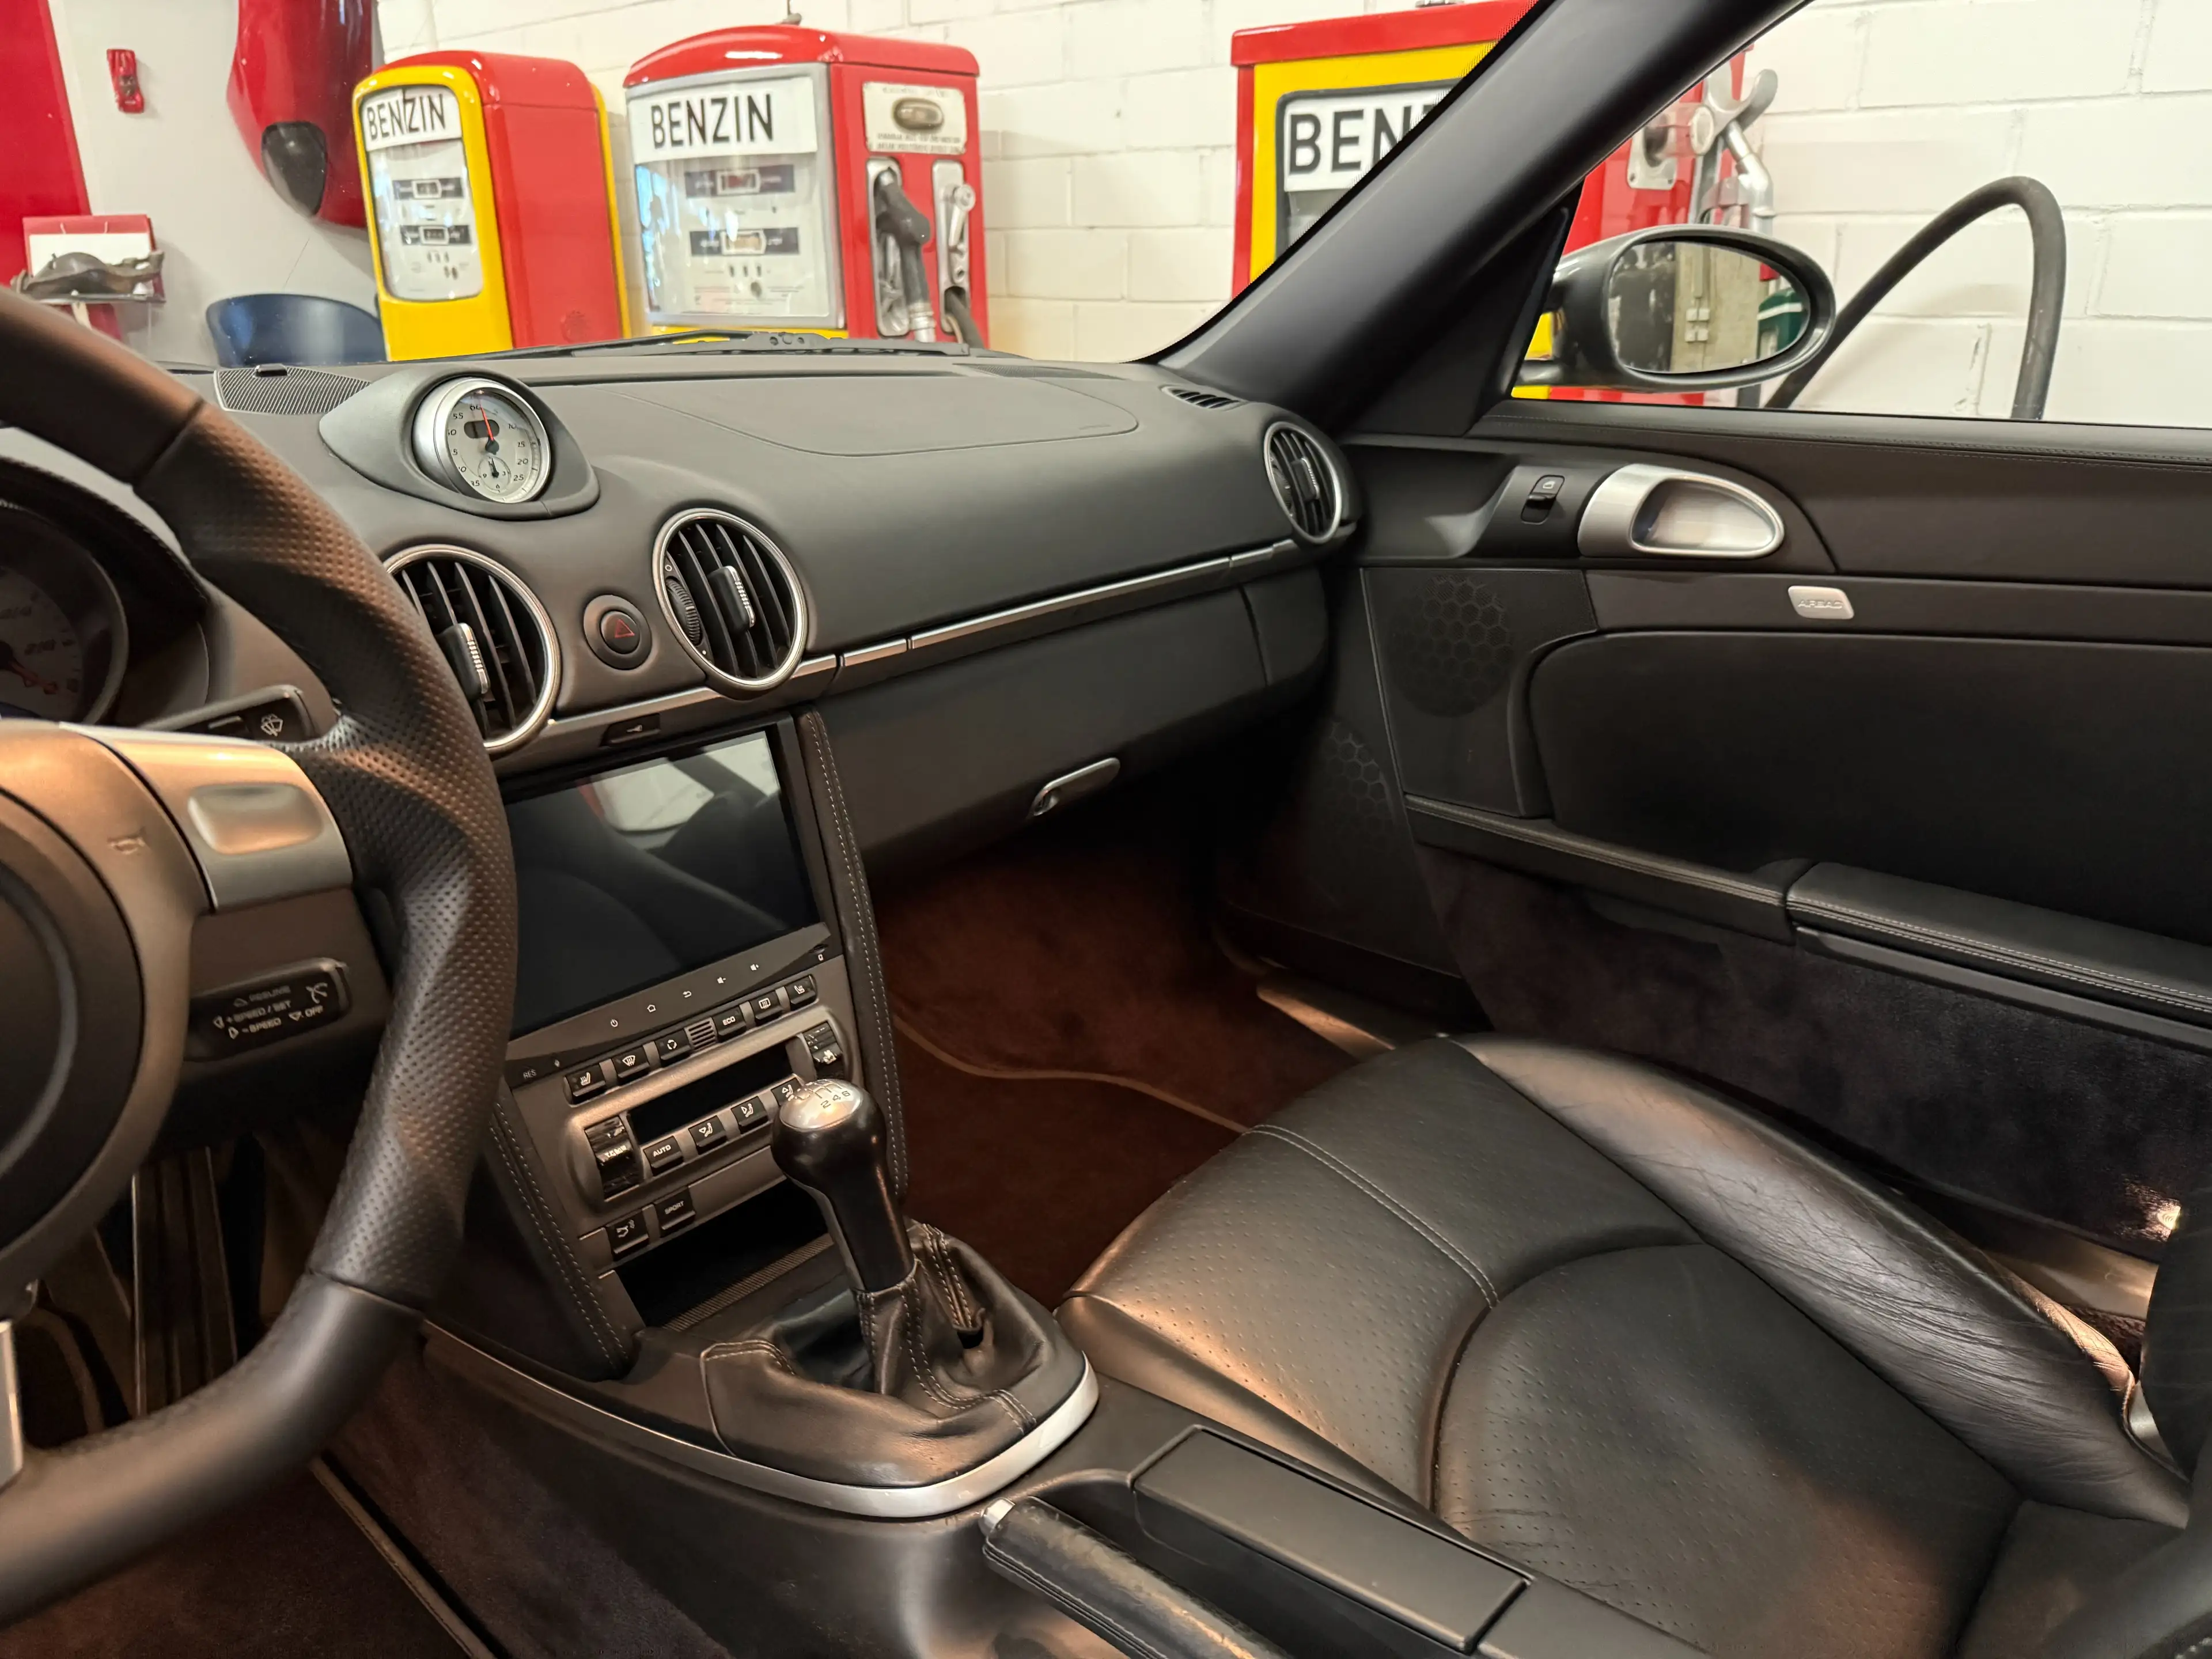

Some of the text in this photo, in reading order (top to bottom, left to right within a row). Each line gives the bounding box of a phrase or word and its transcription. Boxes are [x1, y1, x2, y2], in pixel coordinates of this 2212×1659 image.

[367, 94, 446, 140] BENZIN
[651, 93, 774, 149] BENZIN
[1290, 105, 1434, 174] BEN
[722, 1016, 736, 1026] ECO
[820, 1100, 831, 1109] 2
[653, 1144, 672, 1157] AUTO
[664, 1200, 685, 1215] SPORT
